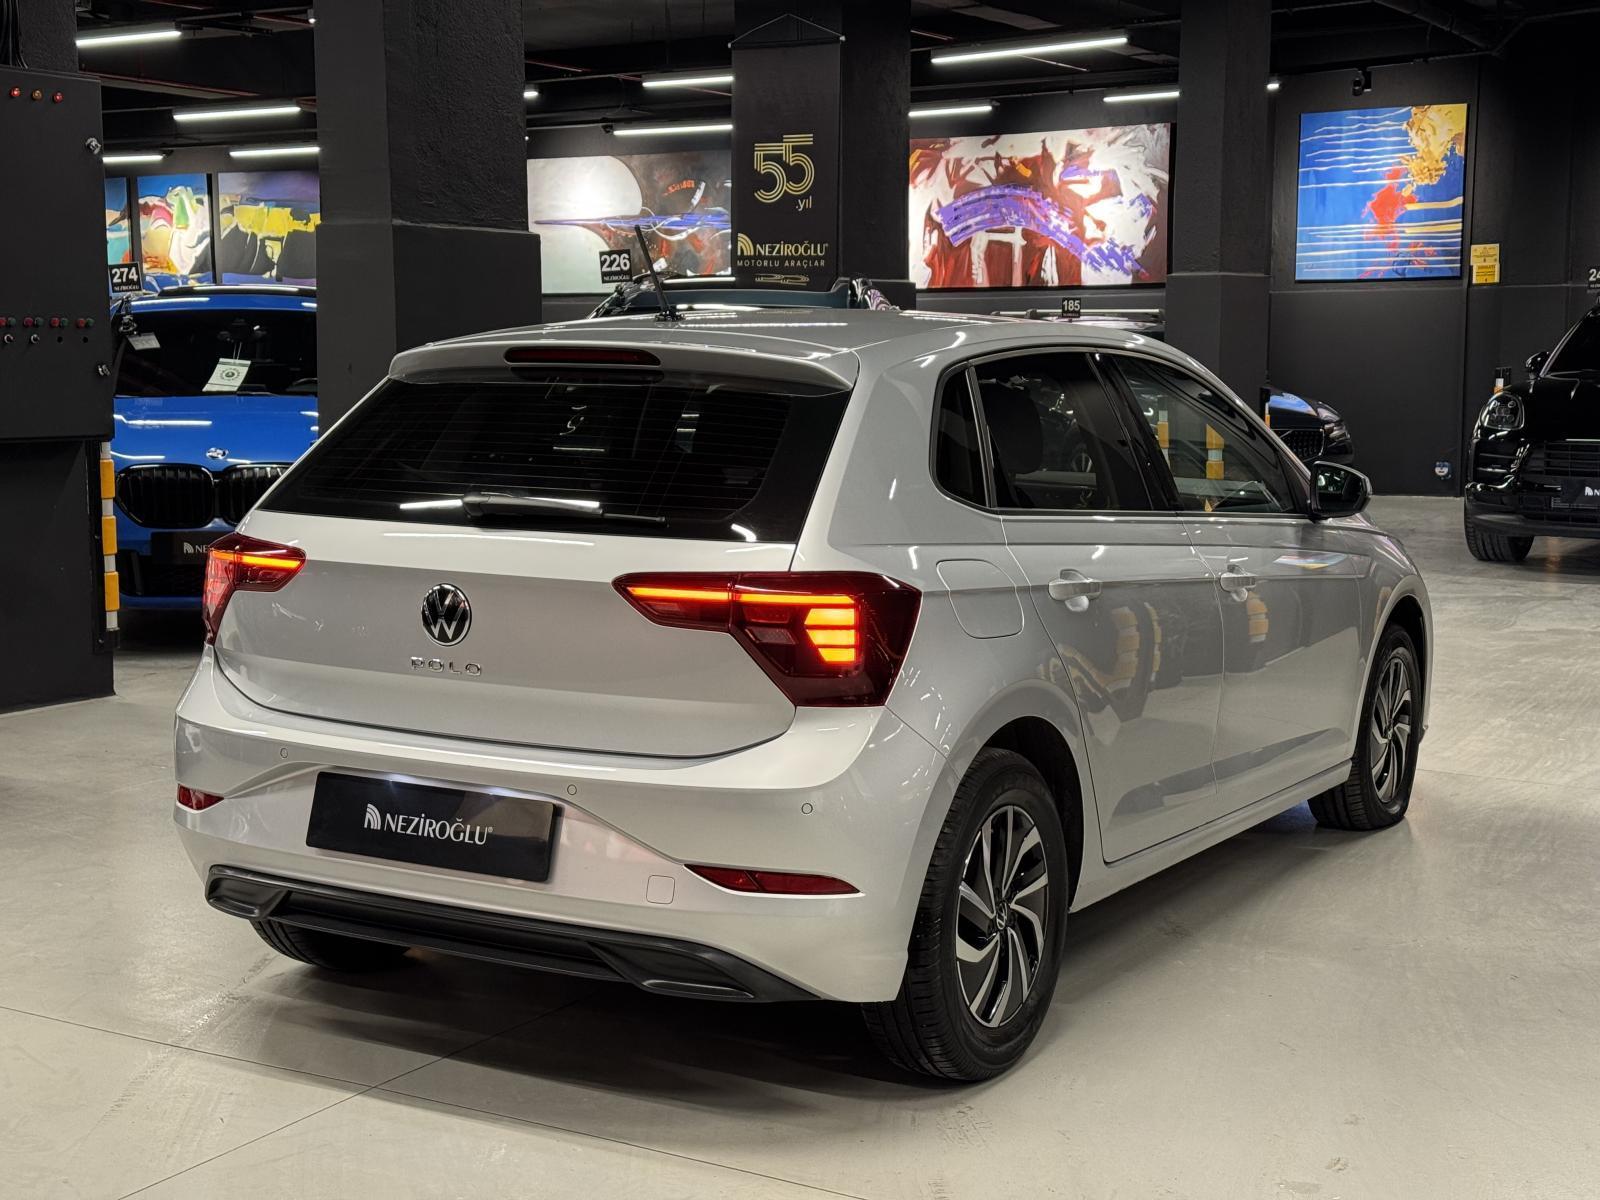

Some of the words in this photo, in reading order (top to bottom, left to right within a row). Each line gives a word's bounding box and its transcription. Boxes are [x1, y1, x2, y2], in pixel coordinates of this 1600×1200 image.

[754, 133, 815, 203] 55
[601, 253, 630, 271] 226
[784, 260, 825, 268] ARAÇLAR
[111, 266, 138, 283] 274
[1062, 299, 1081, 311] 185
[410, 656, 482, 676] POLO
